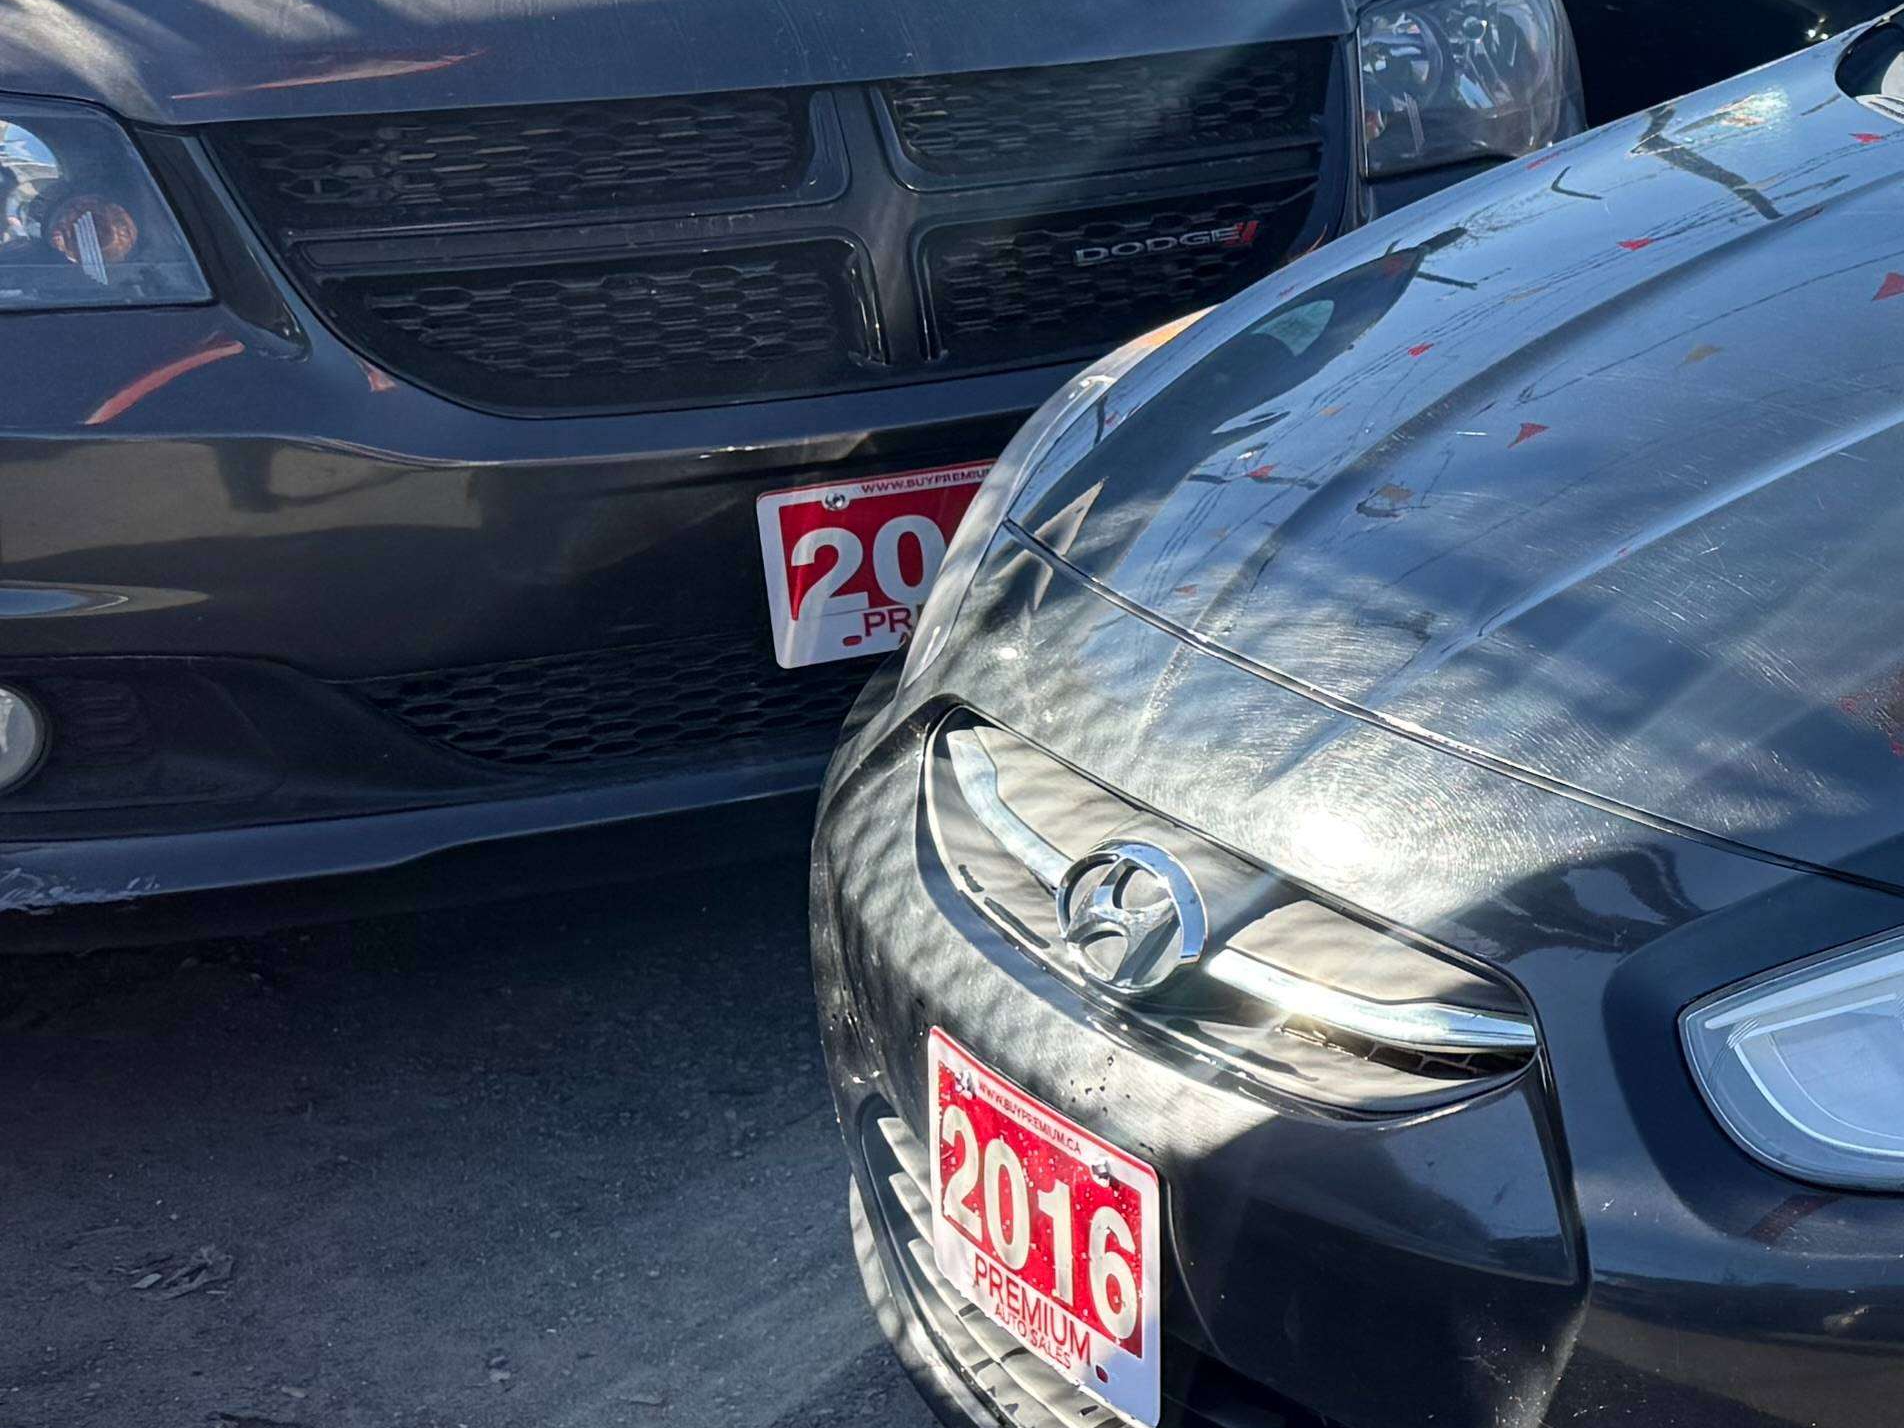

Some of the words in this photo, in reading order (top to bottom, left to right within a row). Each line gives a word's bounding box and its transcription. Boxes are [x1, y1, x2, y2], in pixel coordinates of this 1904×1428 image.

[1076, 225, 1240, 267] DODGE
[942, 1105, 1138, 1340] 2016
[974, 1252, 1091, 1367] PREMIUM
[995, 1304, 1027, 1338] AUTO
[1030, 1328, 1071, 1369] SALES
